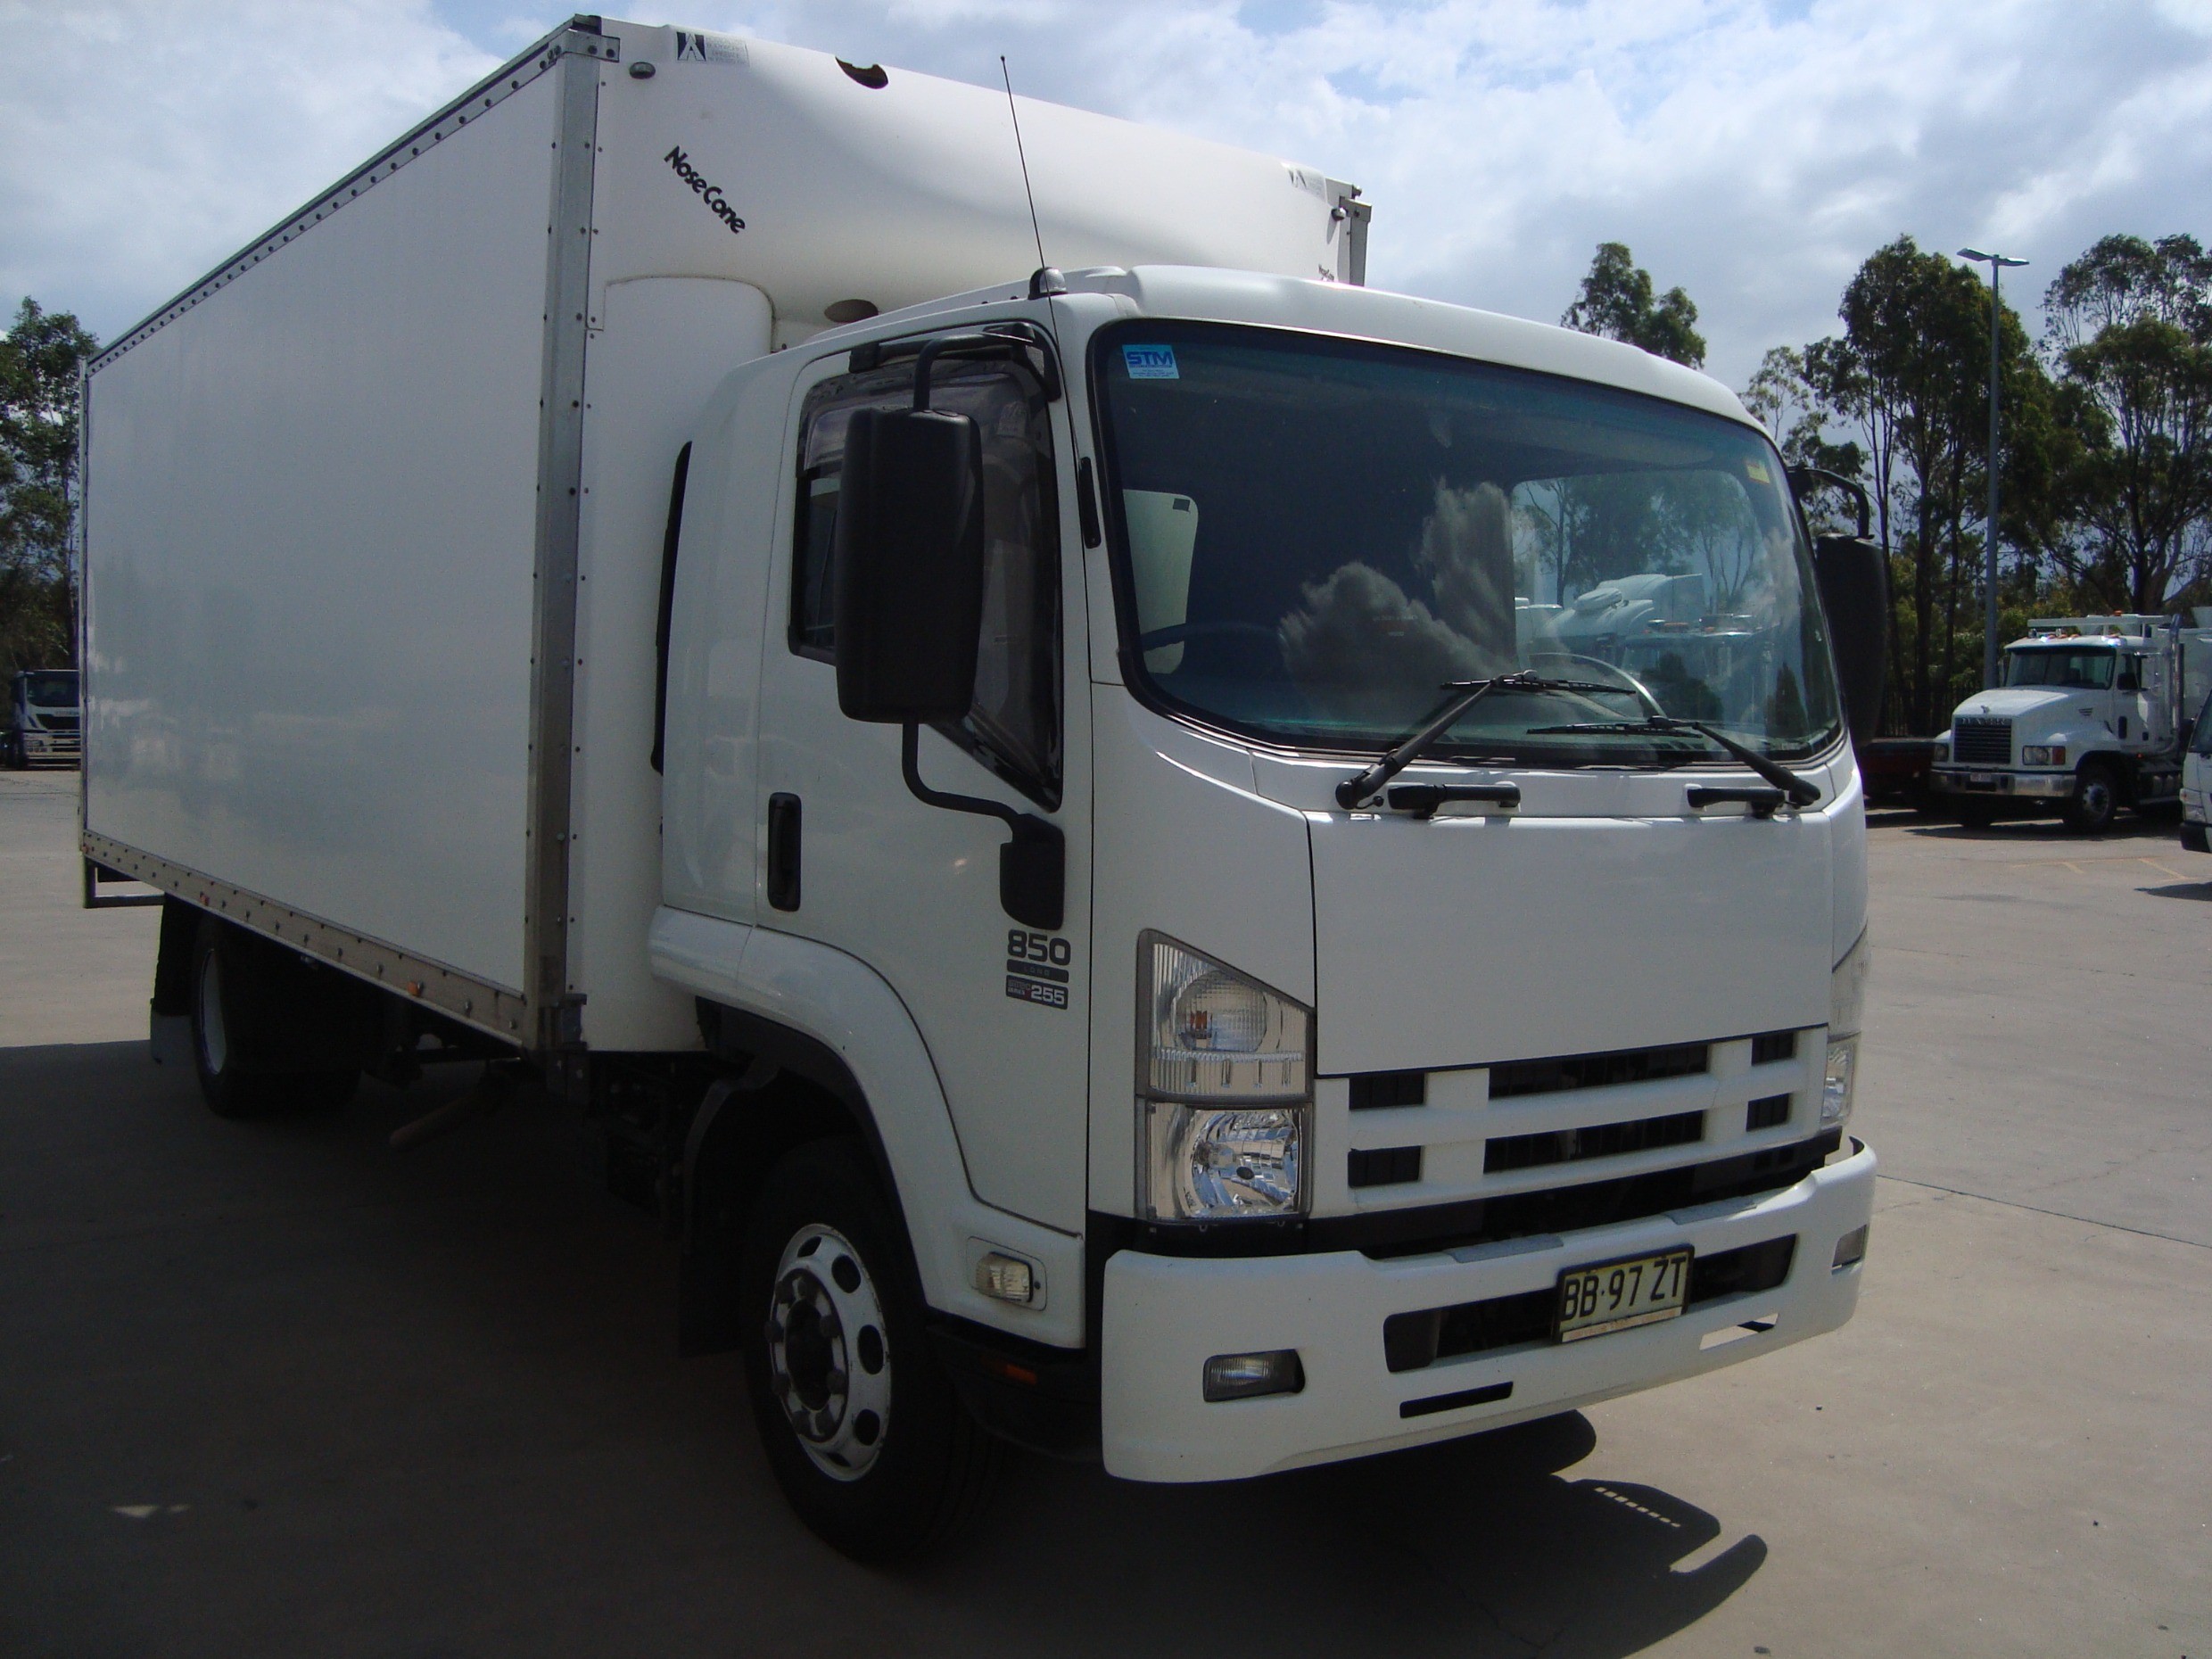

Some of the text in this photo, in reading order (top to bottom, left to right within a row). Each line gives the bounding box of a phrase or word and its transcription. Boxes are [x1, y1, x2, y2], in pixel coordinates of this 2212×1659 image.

[1127, 351, 1174, 366] STM
[1007, 929, 1071, 966] 850
[1030, 985, 1065, 1005] 255
